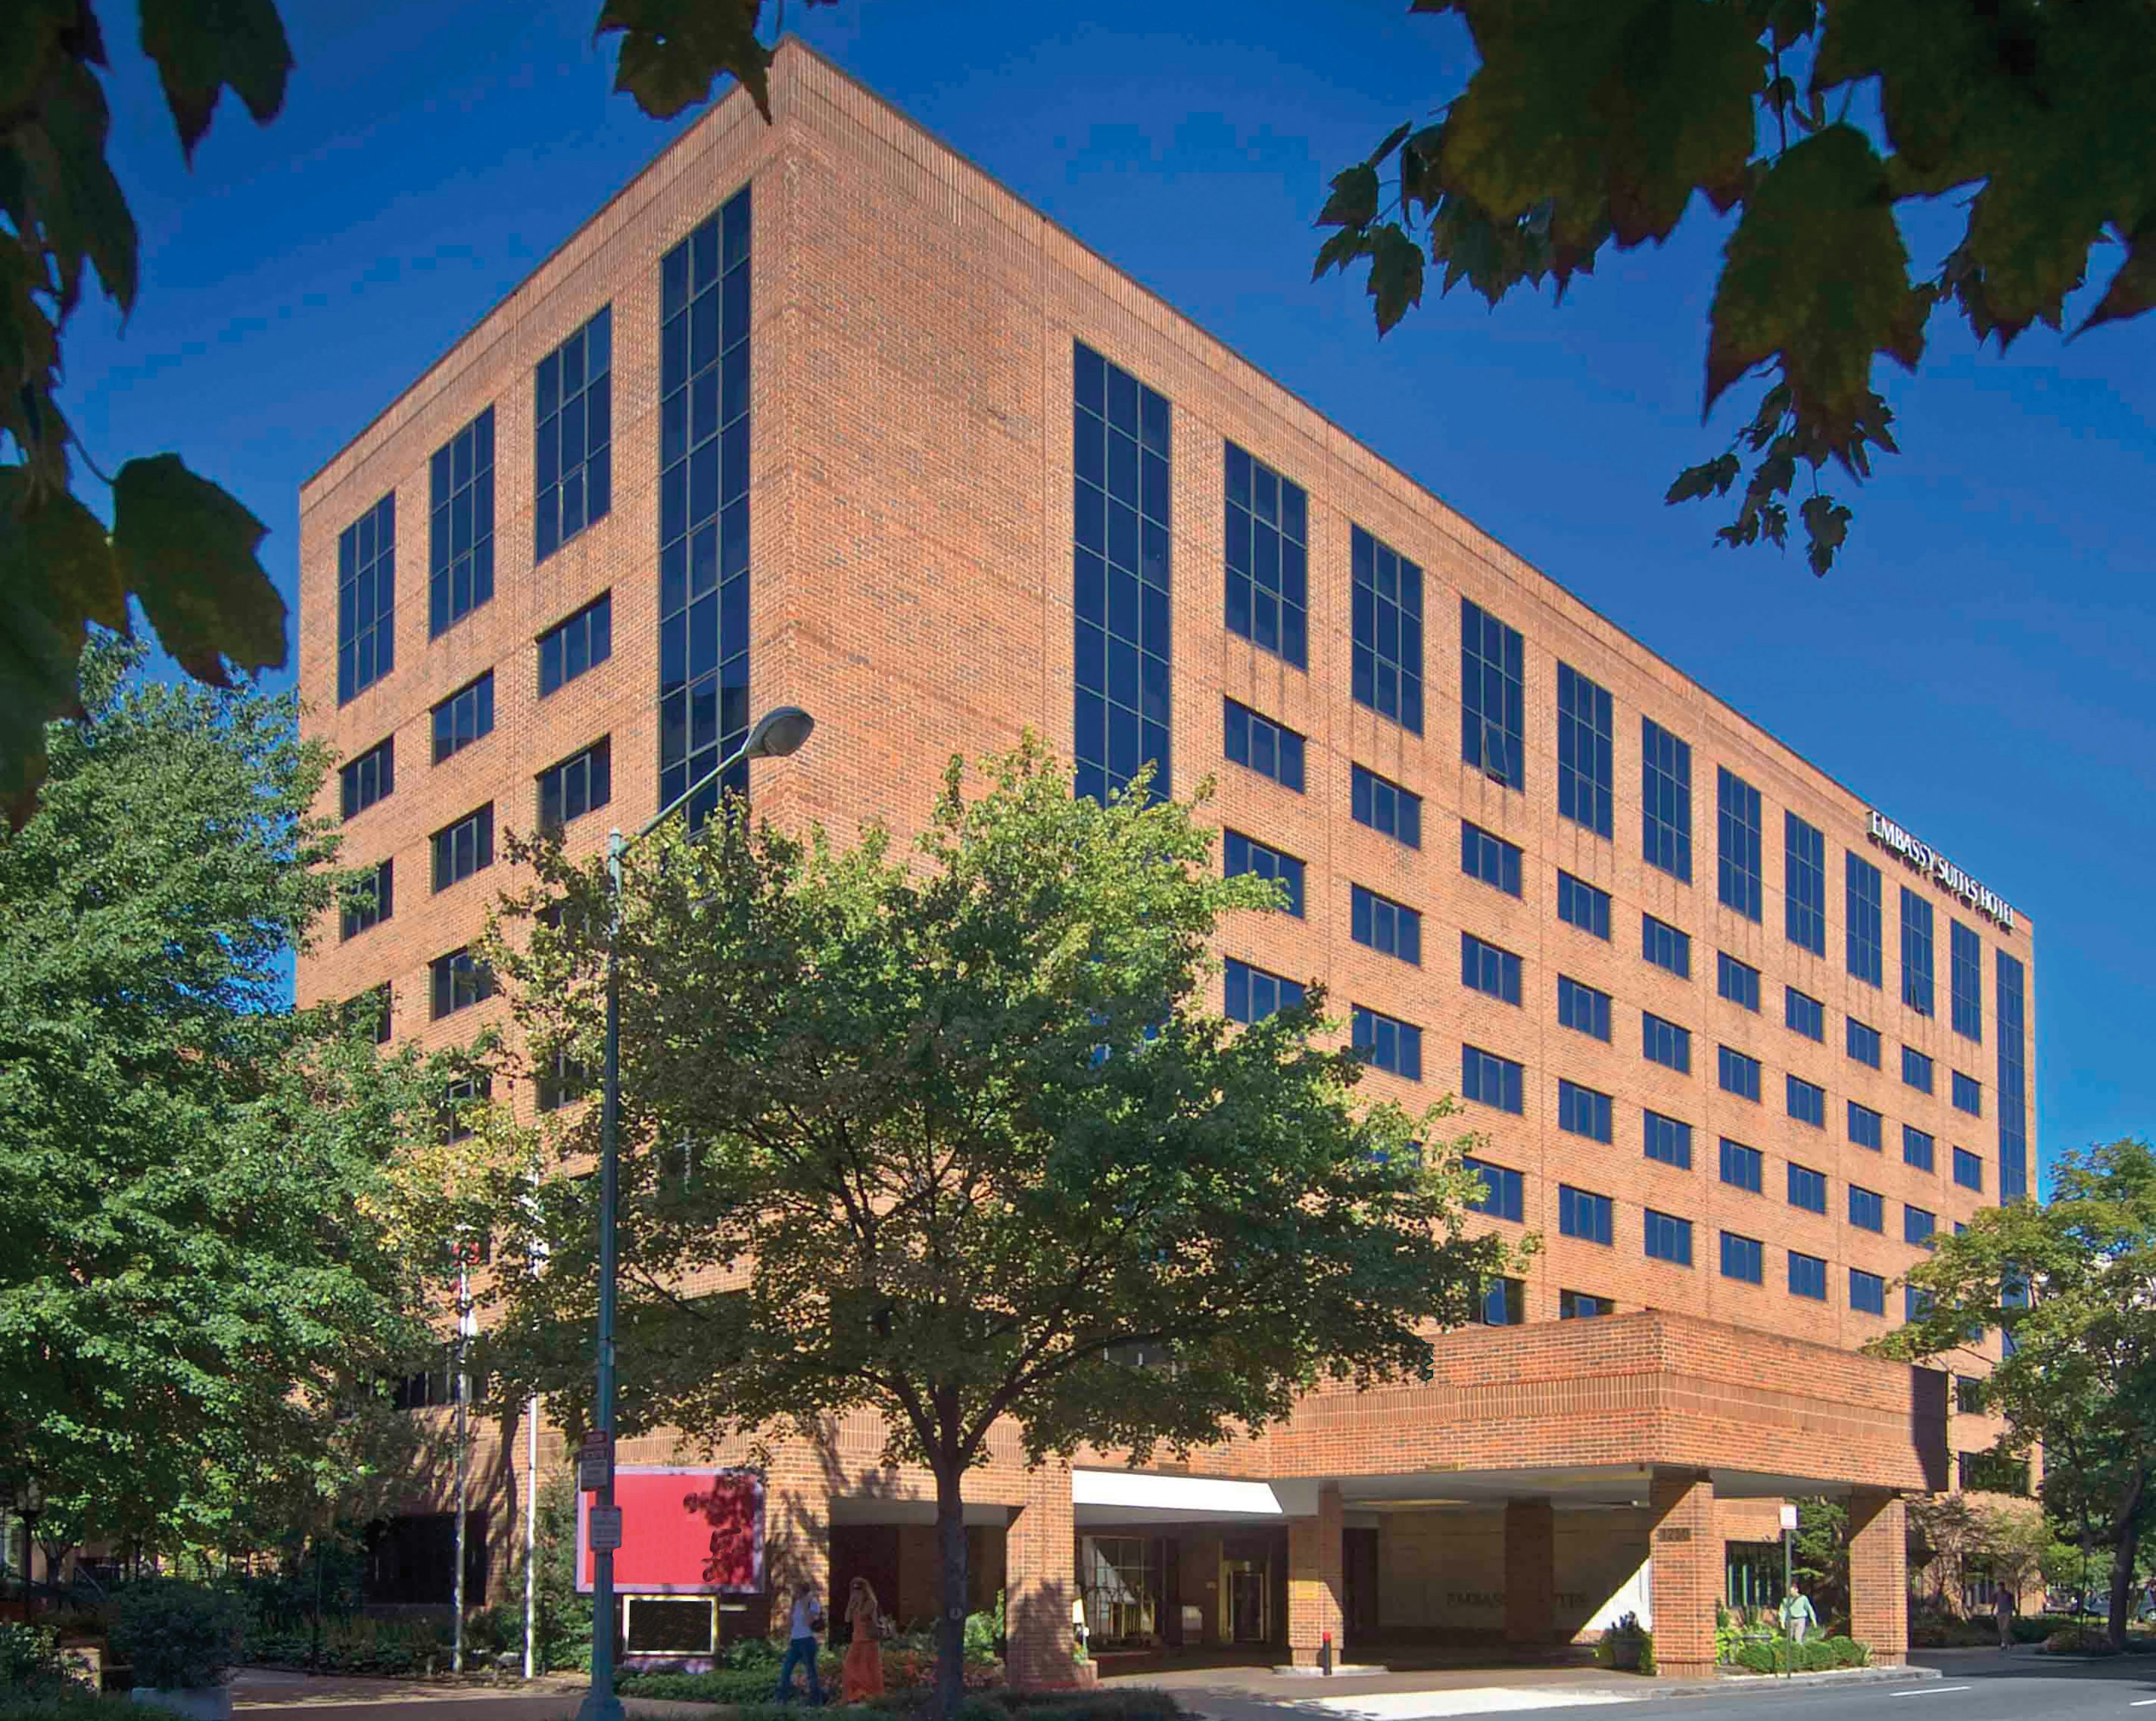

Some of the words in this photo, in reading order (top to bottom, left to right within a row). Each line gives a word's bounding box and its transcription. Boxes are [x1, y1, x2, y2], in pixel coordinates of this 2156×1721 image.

[1870, 810, 1936, 871] EMBASSY
[1936, 856, 1979, 902] SUITES
[1979, 884, 2015, 928] HOTEL
